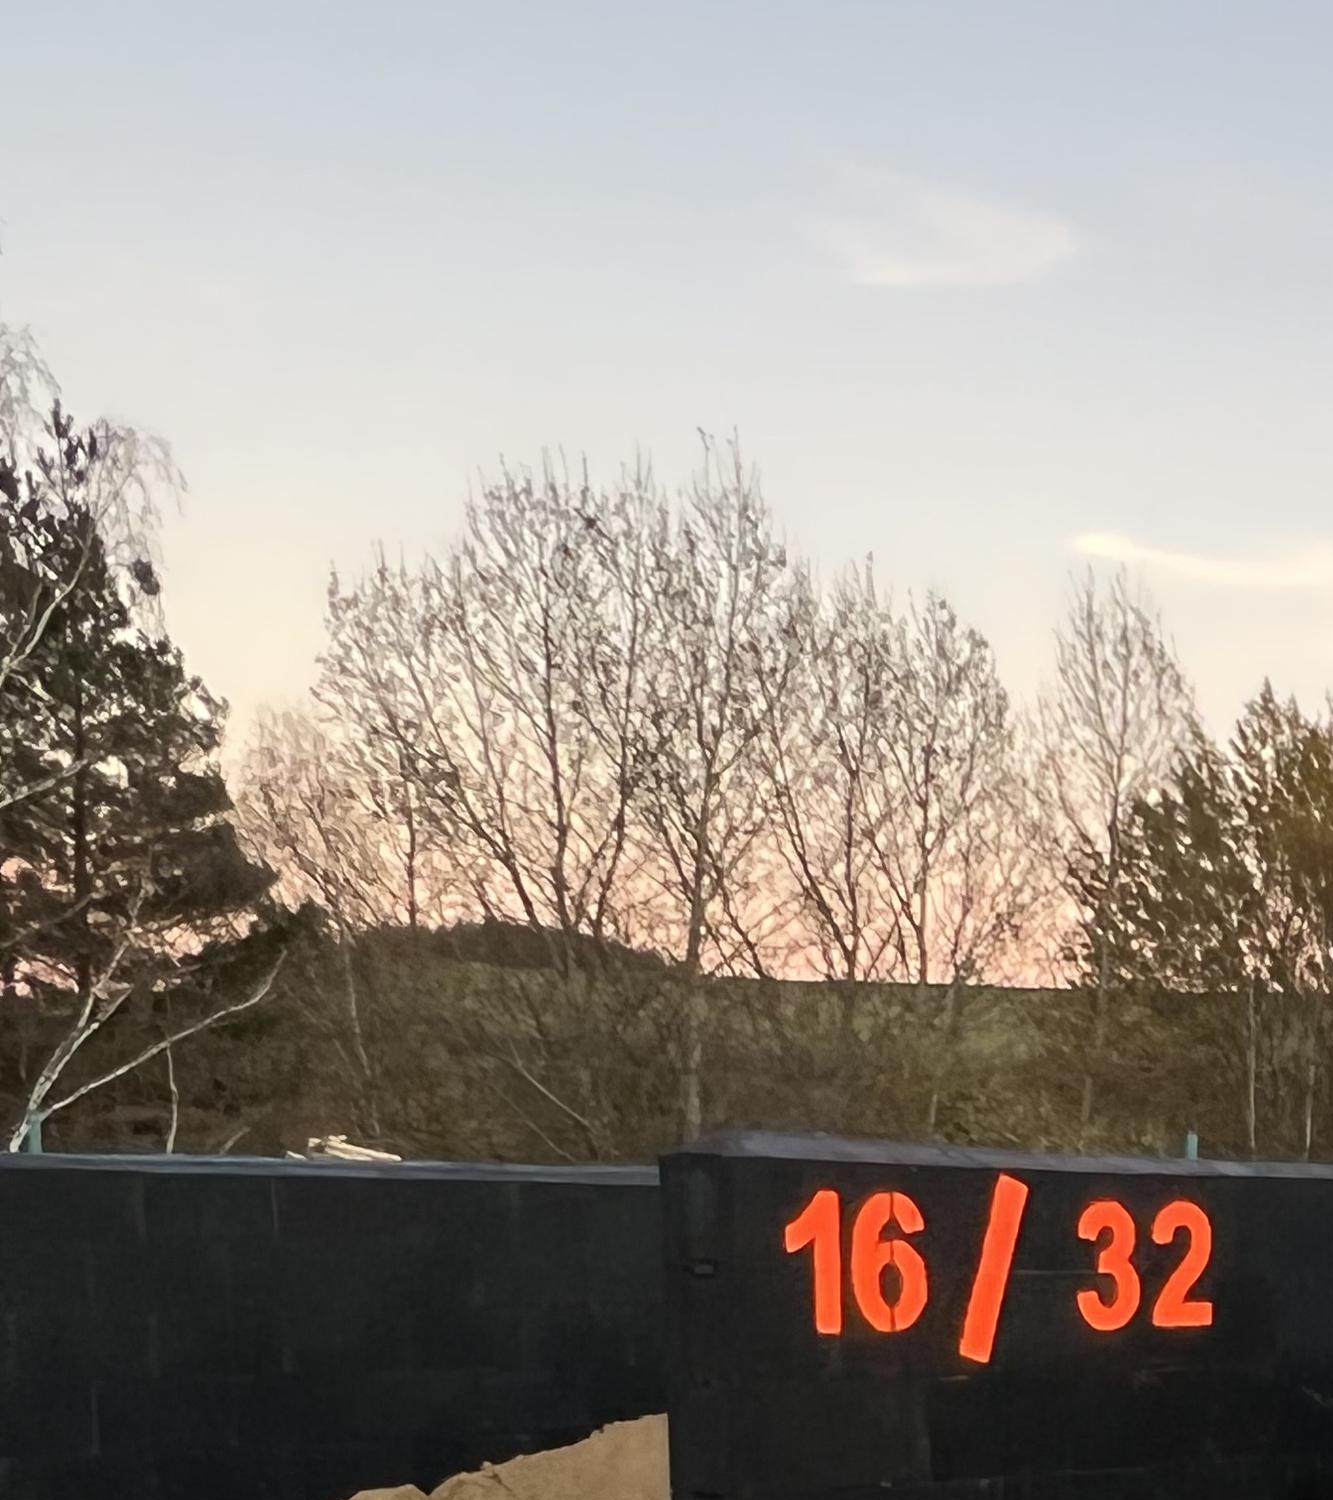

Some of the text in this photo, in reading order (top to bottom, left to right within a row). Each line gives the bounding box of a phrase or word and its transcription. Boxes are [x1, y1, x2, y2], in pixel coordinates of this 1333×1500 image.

[784, 1173, 1213, 1364] 16 / 32
